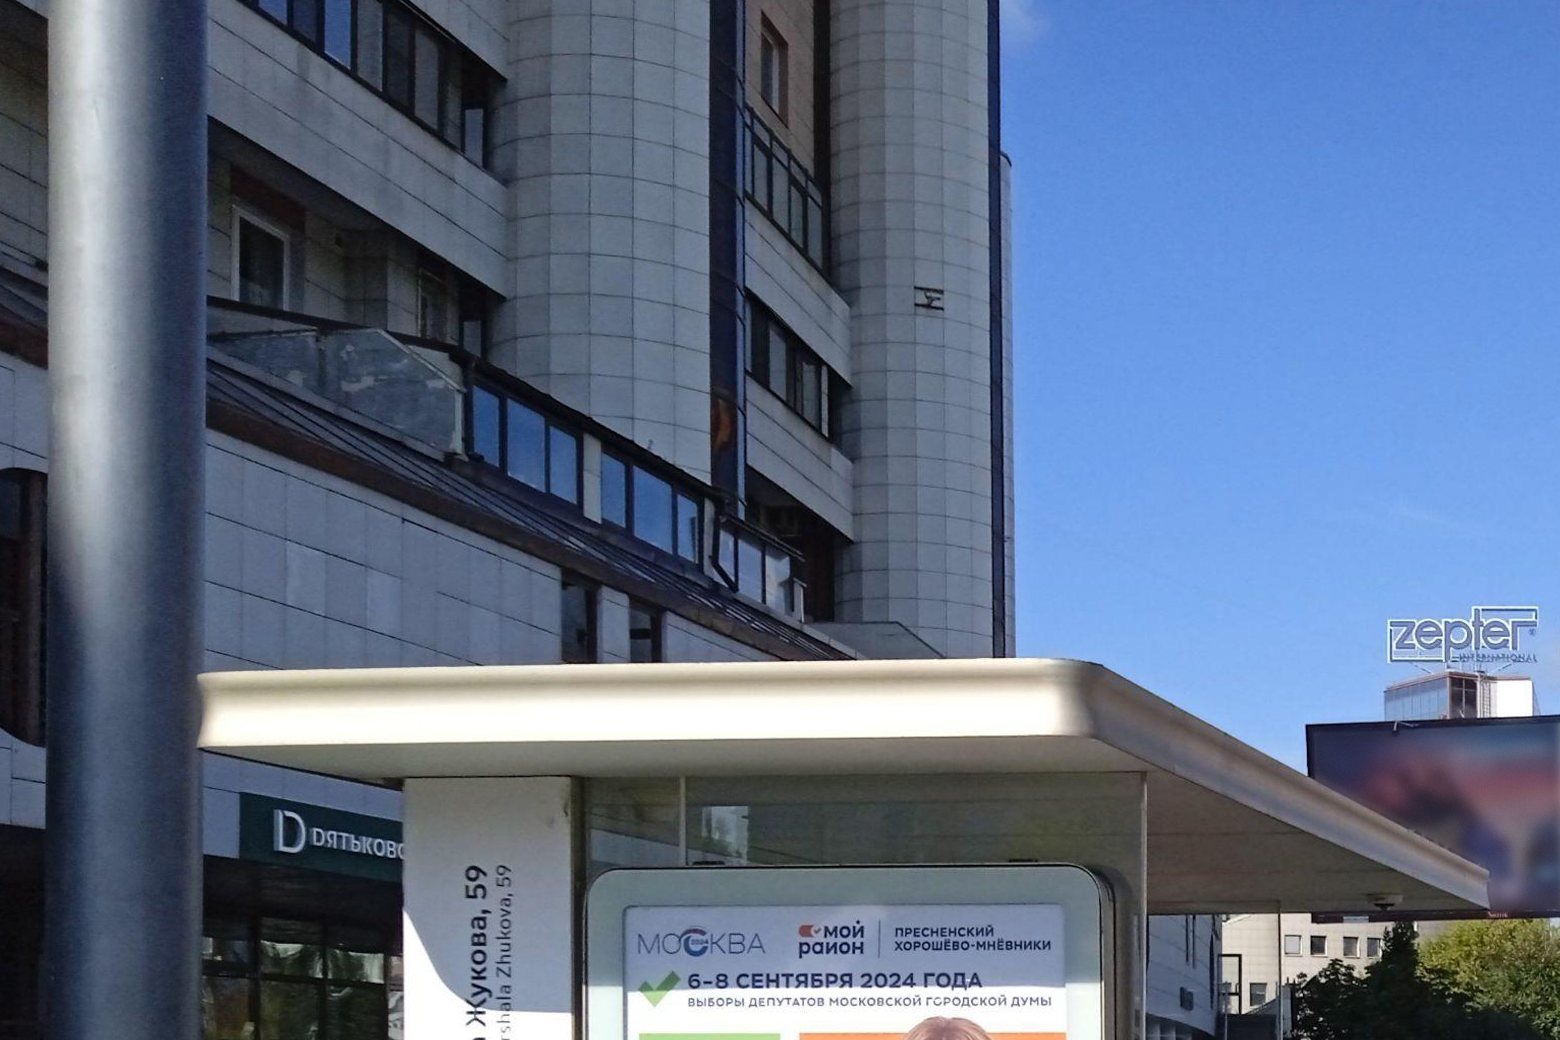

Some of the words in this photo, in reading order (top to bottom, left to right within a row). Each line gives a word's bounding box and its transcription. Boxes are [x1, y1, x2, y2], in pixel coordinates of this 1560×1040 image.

[1389, 606, 1538, 663] zepter
[464, 864, 487, 901] 59
[495, 864, 512, 888] 59
[495, 892, 514, 978] Zhukova,
[895, 925, 994, 938] ПРЕСНЕНСКИЙ
[895, 938, 1051, 951] ХОРОШЁВО-МНЁВНИКИ
[465, 908, 491, 1027] Жукова,
[736, 973, 853, 989] СЕНТЯБРЯ
[860, 973, 917, 989] 2024
[924, 972, 983, 991] ГОДА
[688, 997, 745, 1008] ВЫБОРЫ
[748, 997, 825, 1009] ДЕПУТАТОВ
[829, 994, 922, 1007] МОСКОВСКОЙ
[925, 994, 1007, 1008] ГОРОДСКОЙ
[1011, 997, 1052, 1008] ДУМЫ
